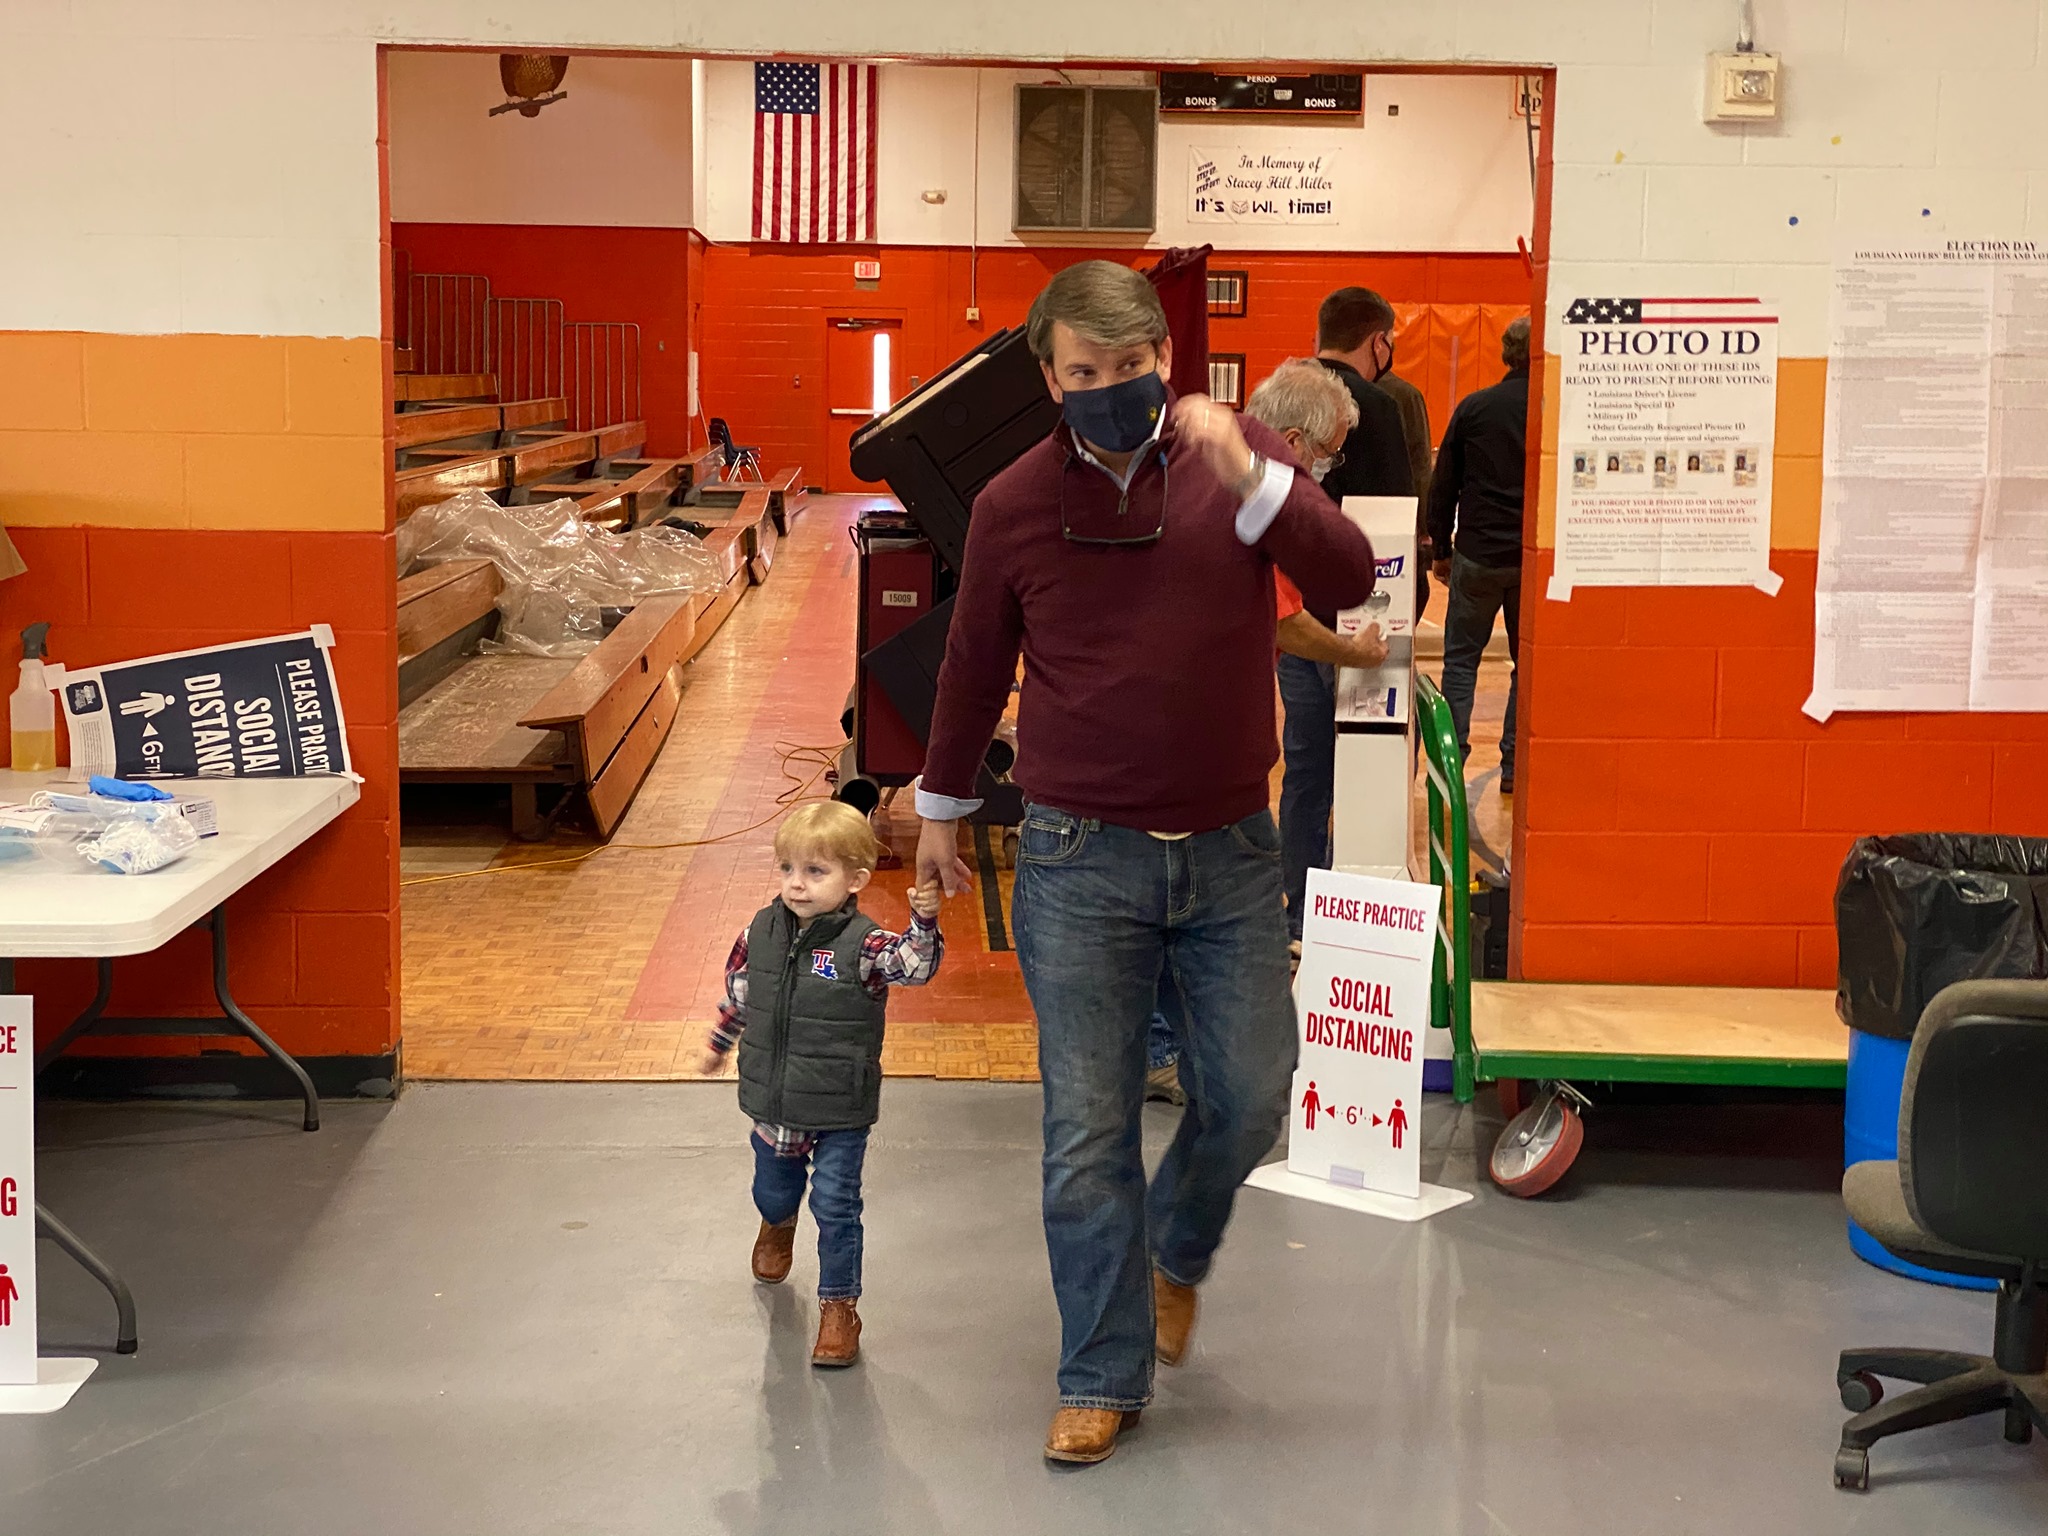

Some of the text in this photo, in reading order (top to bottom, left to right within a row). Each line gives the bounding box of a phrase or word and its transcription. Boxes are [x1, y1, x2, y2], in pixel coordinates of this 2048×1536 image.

[1246, 75, 1277, 83] PERIOD
[1185, 96, 1217, 106] BONUS
[1304, 98, 1336, 107] BONUS
[1238, 154, 1322, 173] In Memory of
[1225, 175, 1332, 192] Stacey Hill Miller
[1196, 197, 1224, 212] It's
[1947, 241, 2037, 251] ELECTION DAY
[859, 263, 876, 276] EXIT
[1579, 330, 1761, 355] PHOTO ID
[1578, 362, 1760, 372] PLEASE HAVE ONE OF THESE IDS
[1566, 376, 1604, 384] READY
[1606, 376, 1621, 384] TO
[1624, 376, 1676, 384] PRESENT
[1678, 376, 1722, 384] BEFORE
[1627, 412, 1638, 420] ID
[889, 594, 912, 603] 15009
[286, 658, 322, 722] PLEASE
[1314, 894, 1426, 932] PLEASE PRACTICE
[1330, 976, 1394, 1018] SOCIAL
[1306, 1011, 1413, 1062] DISTANCING
